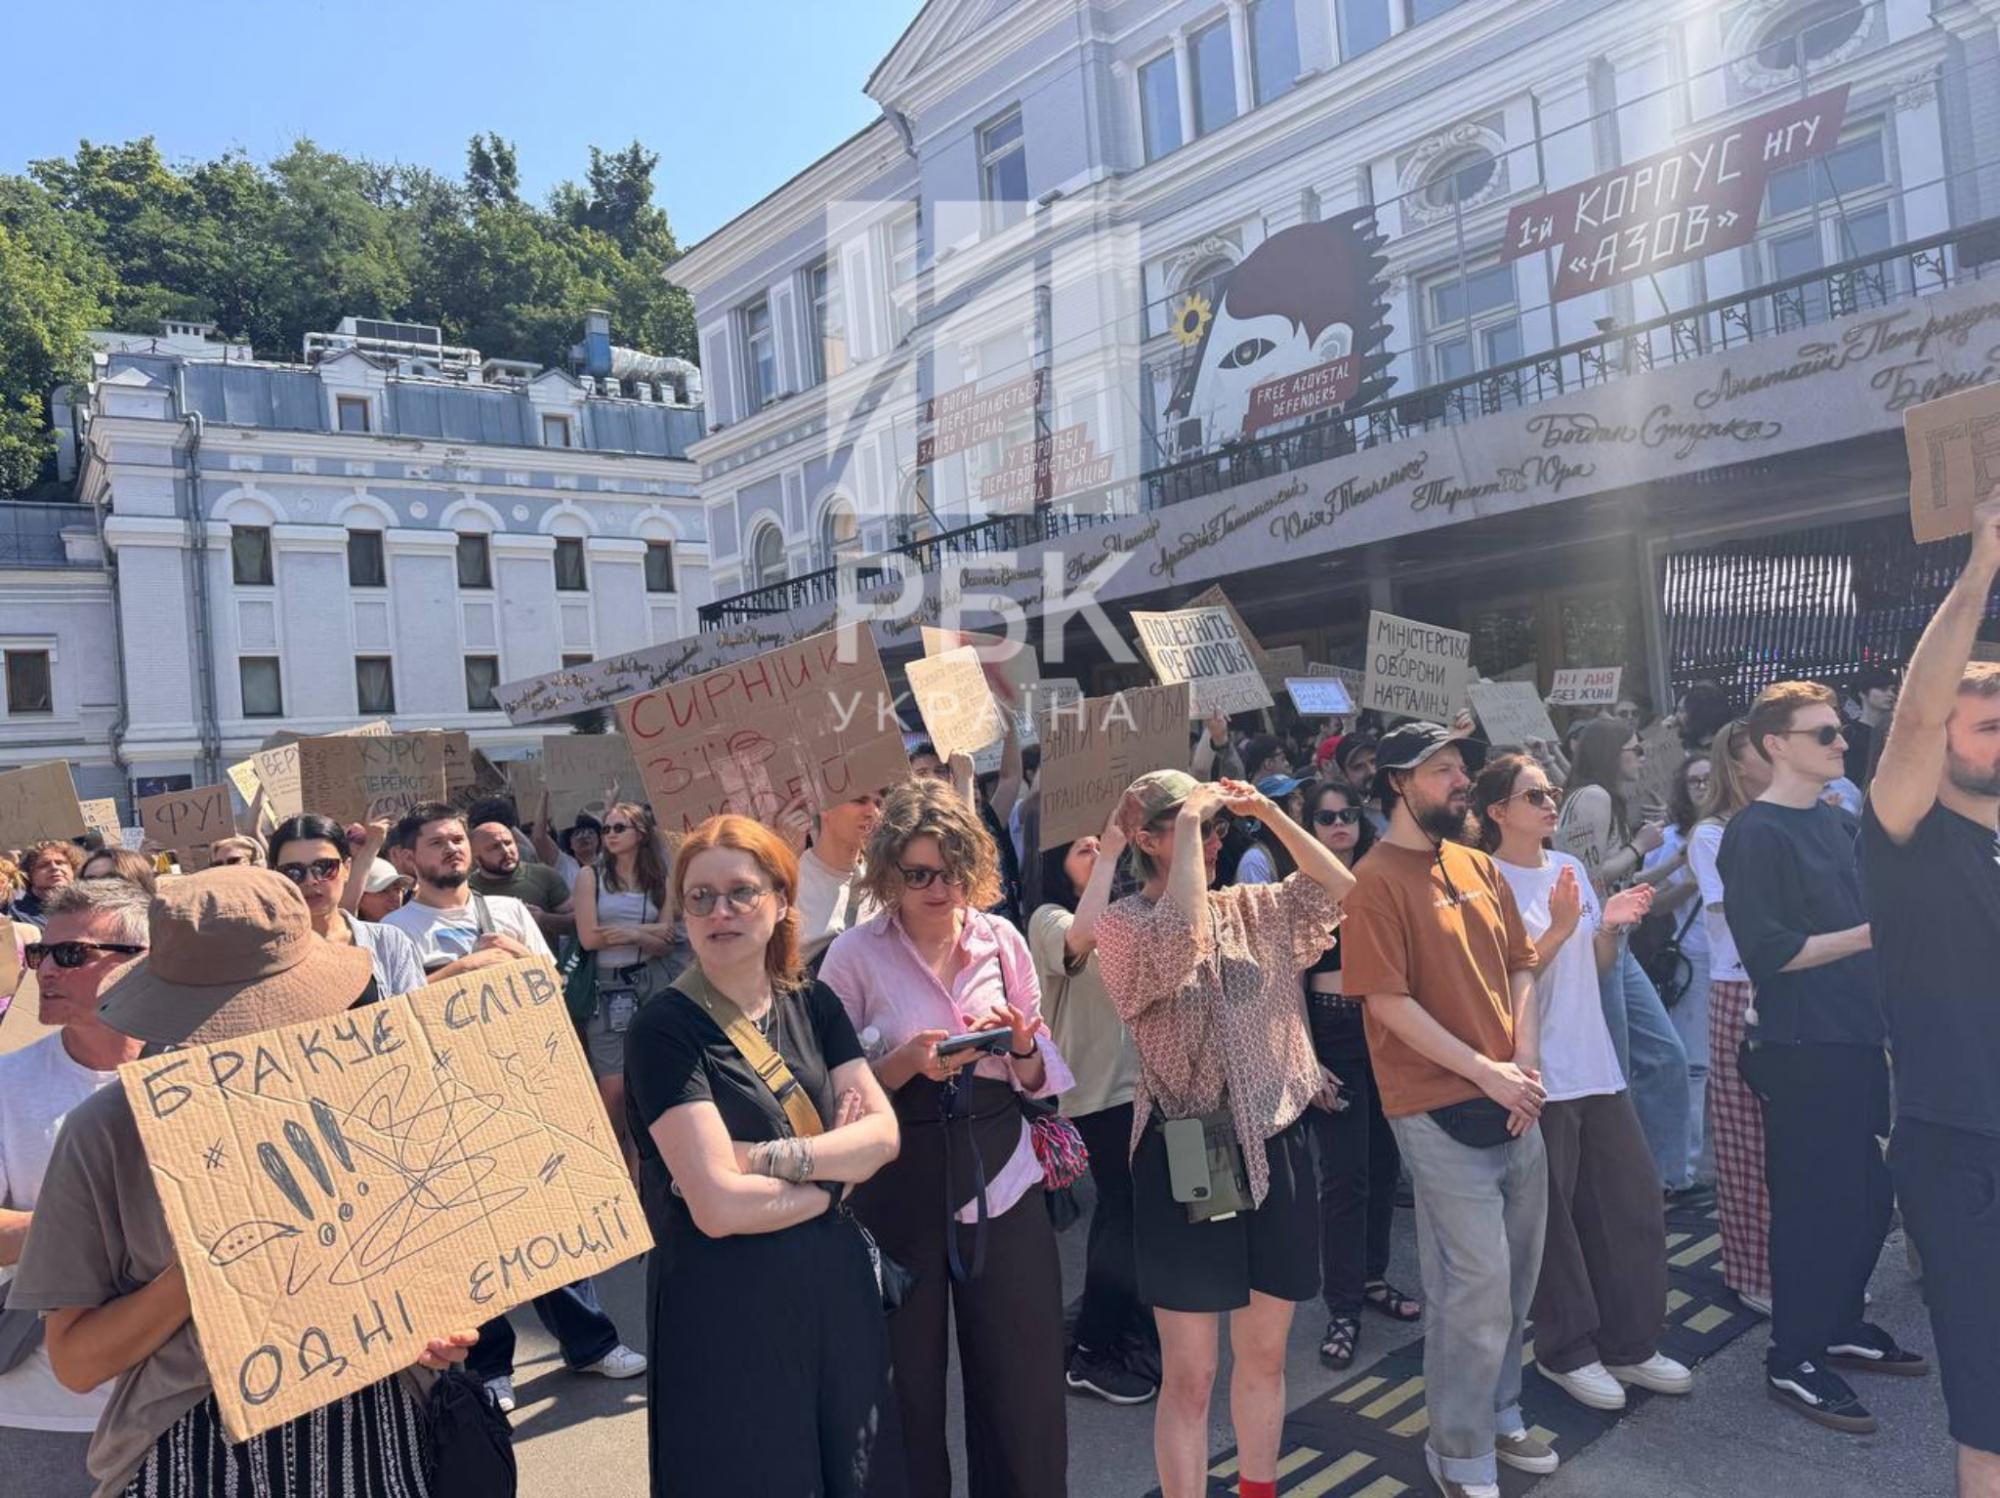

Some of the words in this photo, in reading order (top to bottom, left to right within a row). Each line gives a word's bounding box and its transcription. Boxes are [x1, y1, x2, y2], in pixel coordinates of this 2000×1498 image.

[1574, 133, 1742, 233] КОРПУС
[1763, 115, 1821, 161] НГУ
[1568, 204, 1739, 282] «АЗОВ»
[1256, 382, 1286, 406] FREE
[1292, 361, 1349, 393] AZOVSTAL
[1272, 385, 1337, 418] DEFENDERS
[972, 421, 1004, 441] СТАЛЬ
[1526, 412, 1636, 449] Богдан
[1157, 641, 1253, 679] ФЕДОРОВА
[1375, 649, 1446, 687] ОБОРОНИ
[630, 645, 856, 739] СИРНИК
[359, 737, 425, 764] КУРС
[156, 792, 224, 837] ФУ!
[141, 1008, 408, 1120] БРАКУЄ
[443, 966, 559, 1031] СЛІВ
[238, 1290, 414, 1407] ОДНІ
